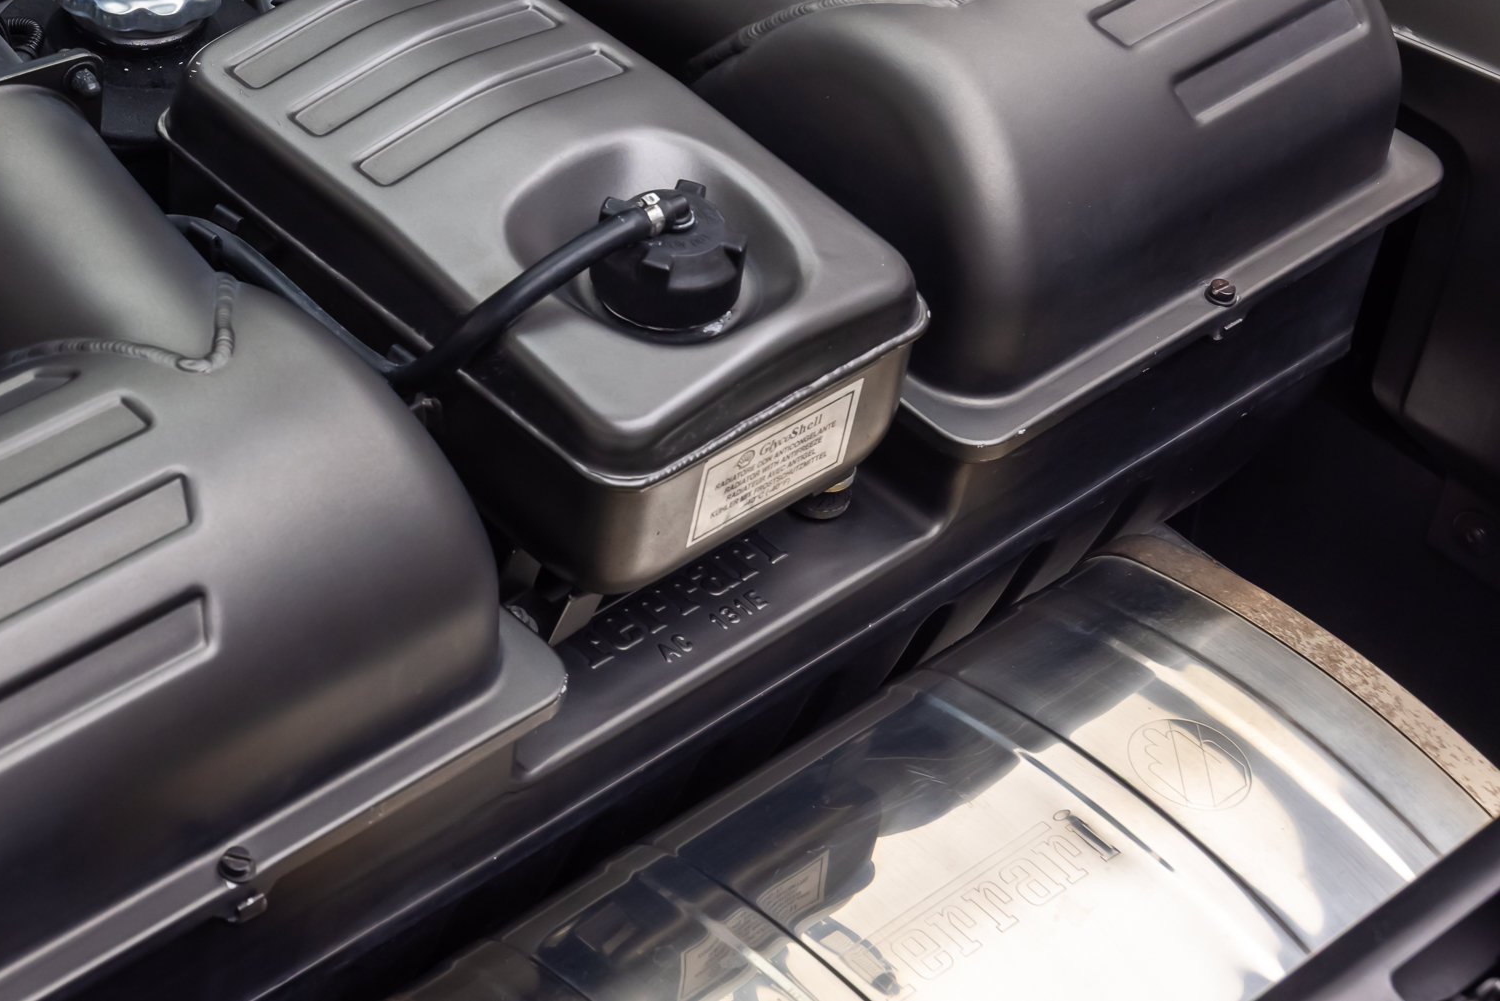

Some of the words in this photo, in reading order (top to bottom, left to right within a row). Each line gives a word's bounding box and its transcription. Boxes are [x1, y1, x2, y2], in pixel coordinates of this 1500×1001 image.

[723, 469, 760, 494] RADIATOR
[657, 634, 693, 663] AC
[709, 590, 769, 630] 131E
